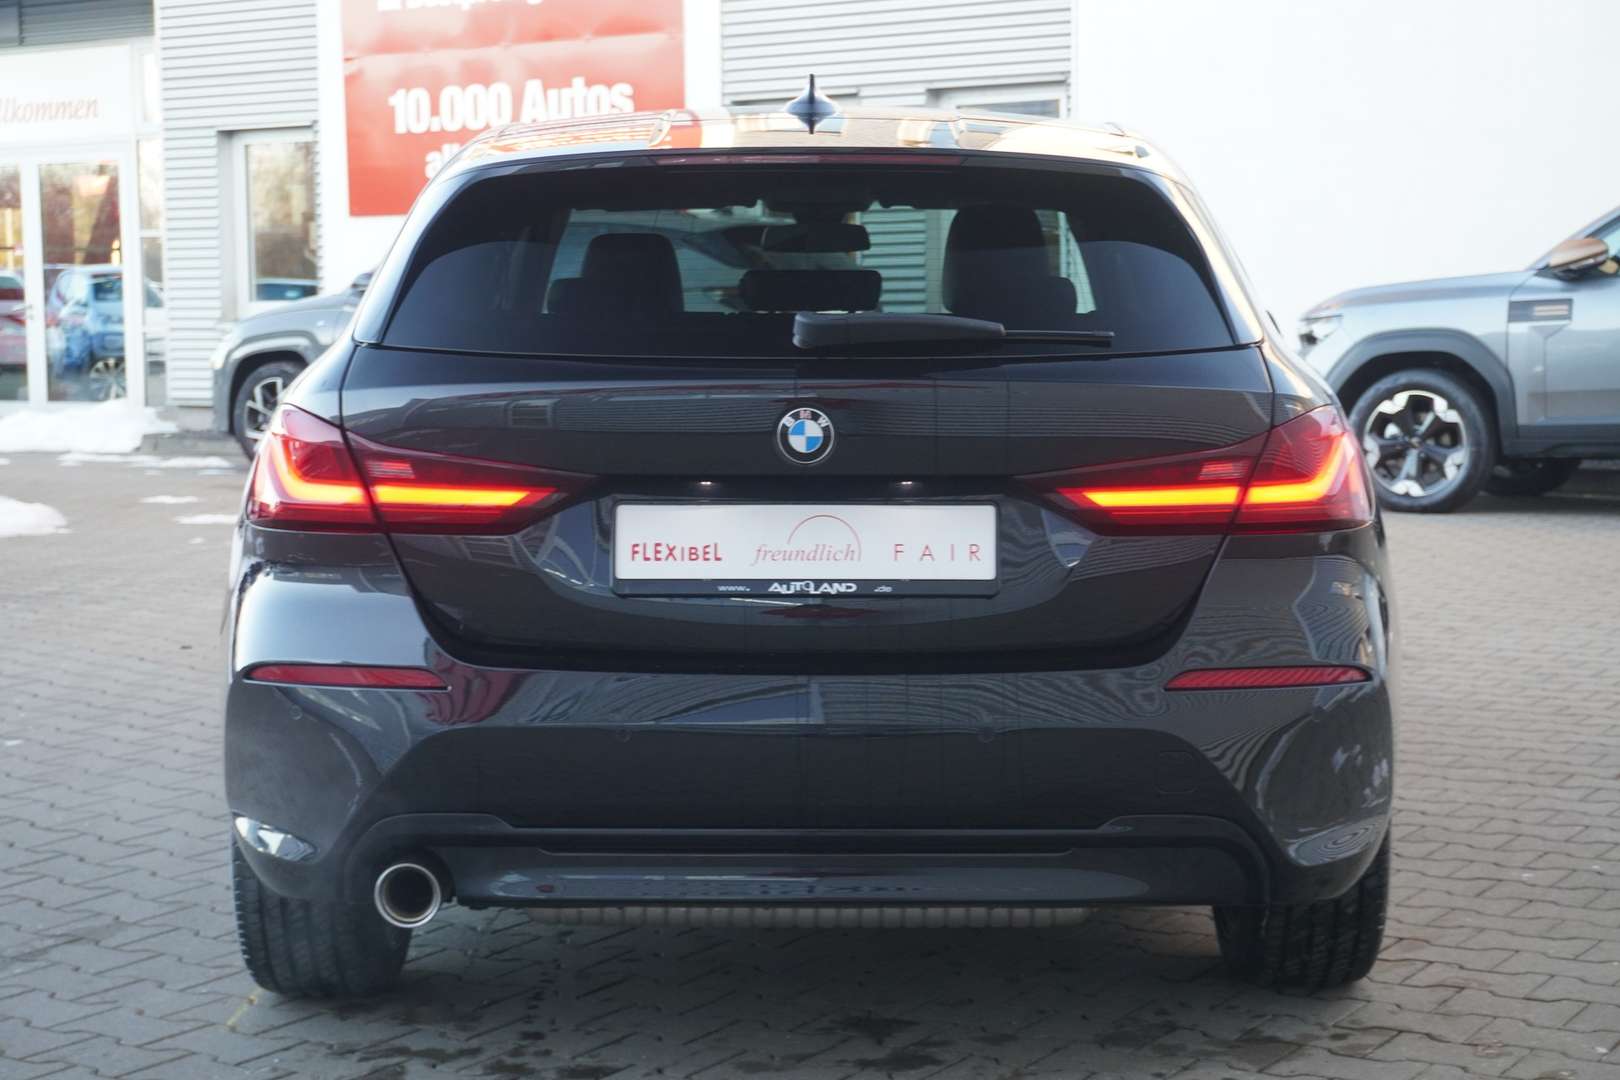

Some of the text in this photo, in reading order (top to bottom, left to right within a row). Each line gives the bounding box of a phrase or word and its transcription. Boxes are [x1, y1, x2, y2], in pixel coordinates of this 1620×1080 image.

[388, 77, 634, 134] 10.000 Autos
[783, 409, 830, 427] BMW
[630, 542, 981, 568] FLEXIBEL freundlich FAIR
[768, 580, 858, 595] AUTOLAND
